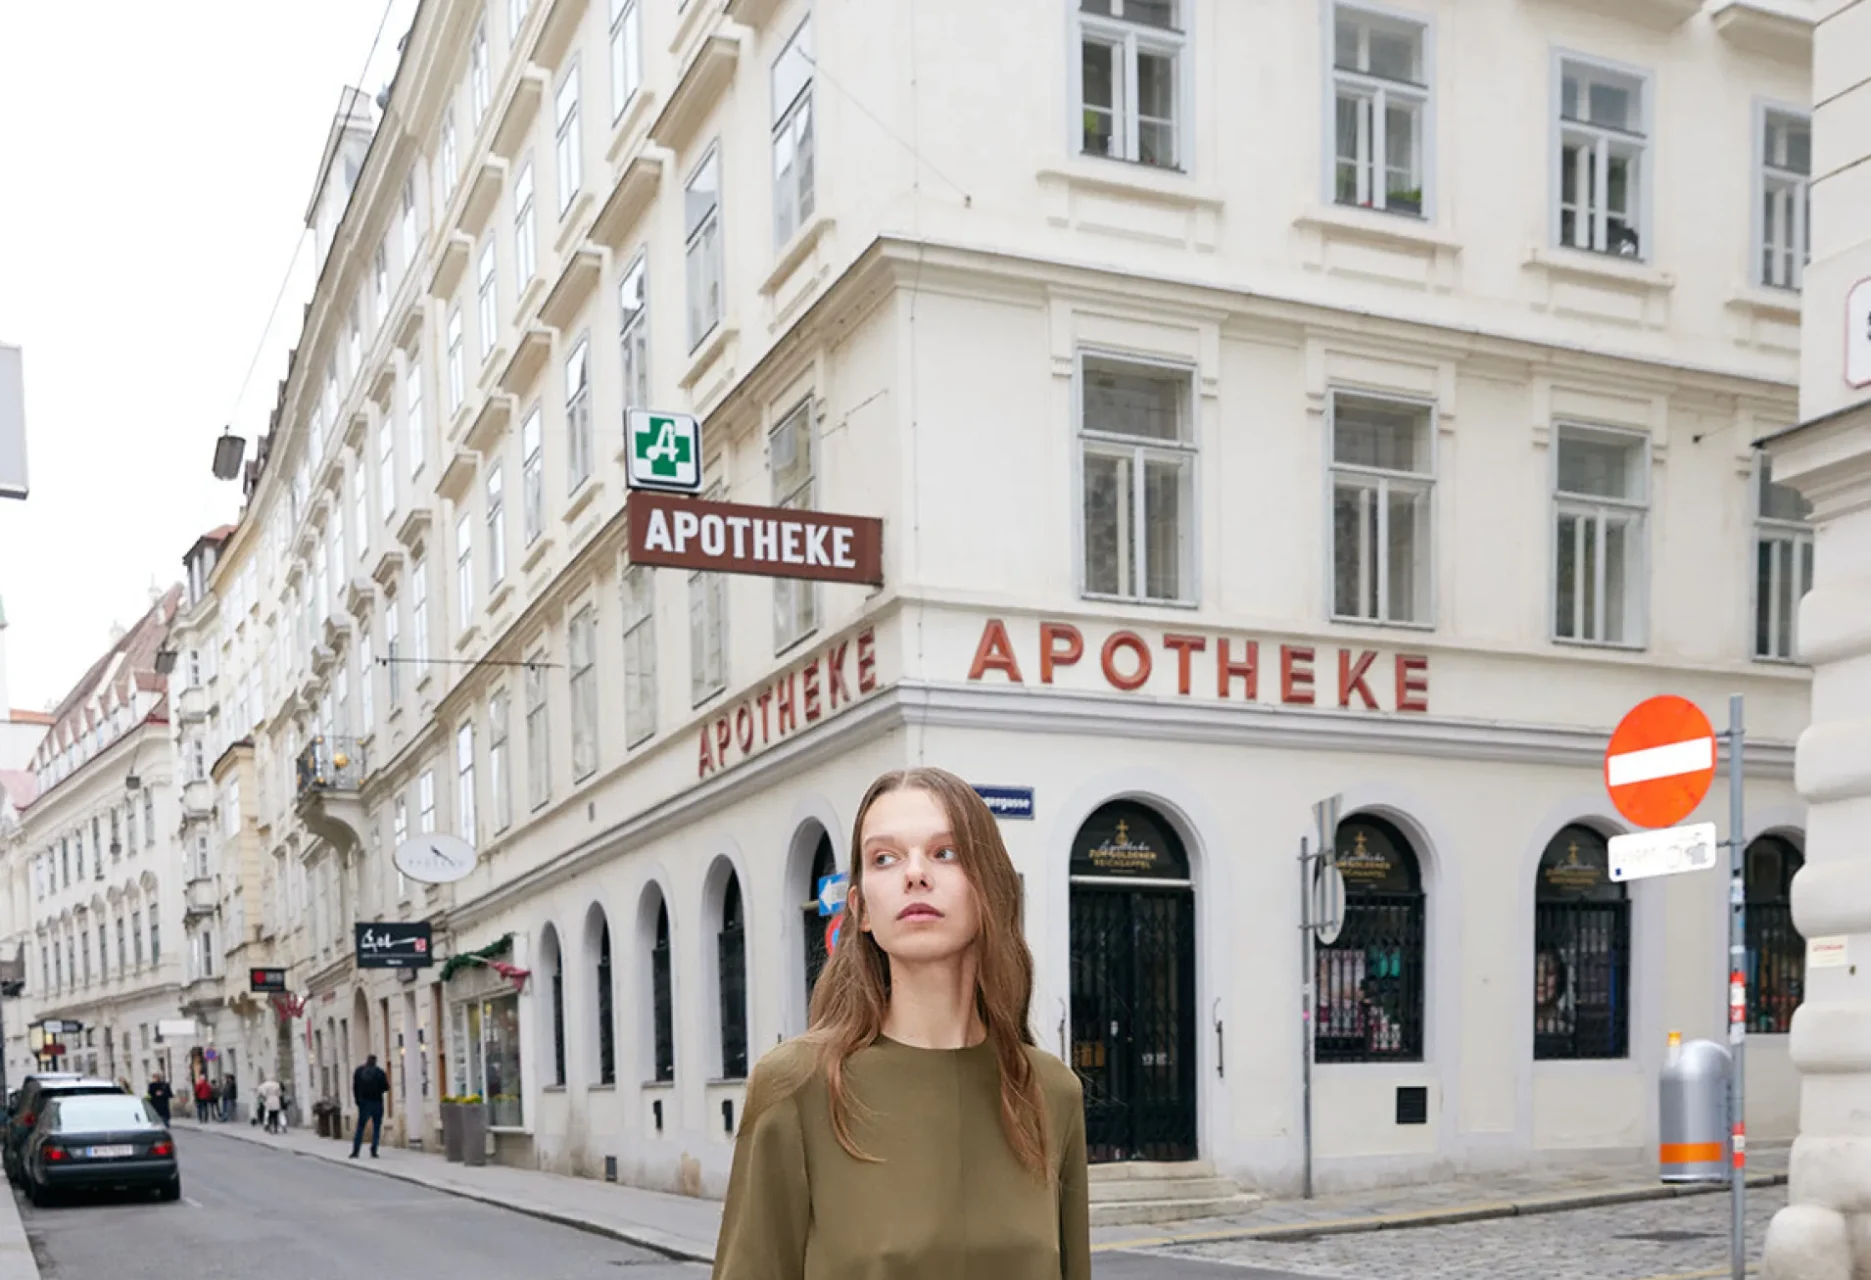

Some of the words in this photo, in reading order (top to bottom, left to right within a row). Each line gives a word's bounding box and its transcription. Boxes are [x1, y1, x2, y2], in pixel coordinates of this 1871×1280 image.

[646, 421, 680, 462] A
[644, 508, 856, 569] APOTHEKE
[698, 625, 878, 778] APOTHEKE
[967, 618, 1429, 712] APOTHEKE
